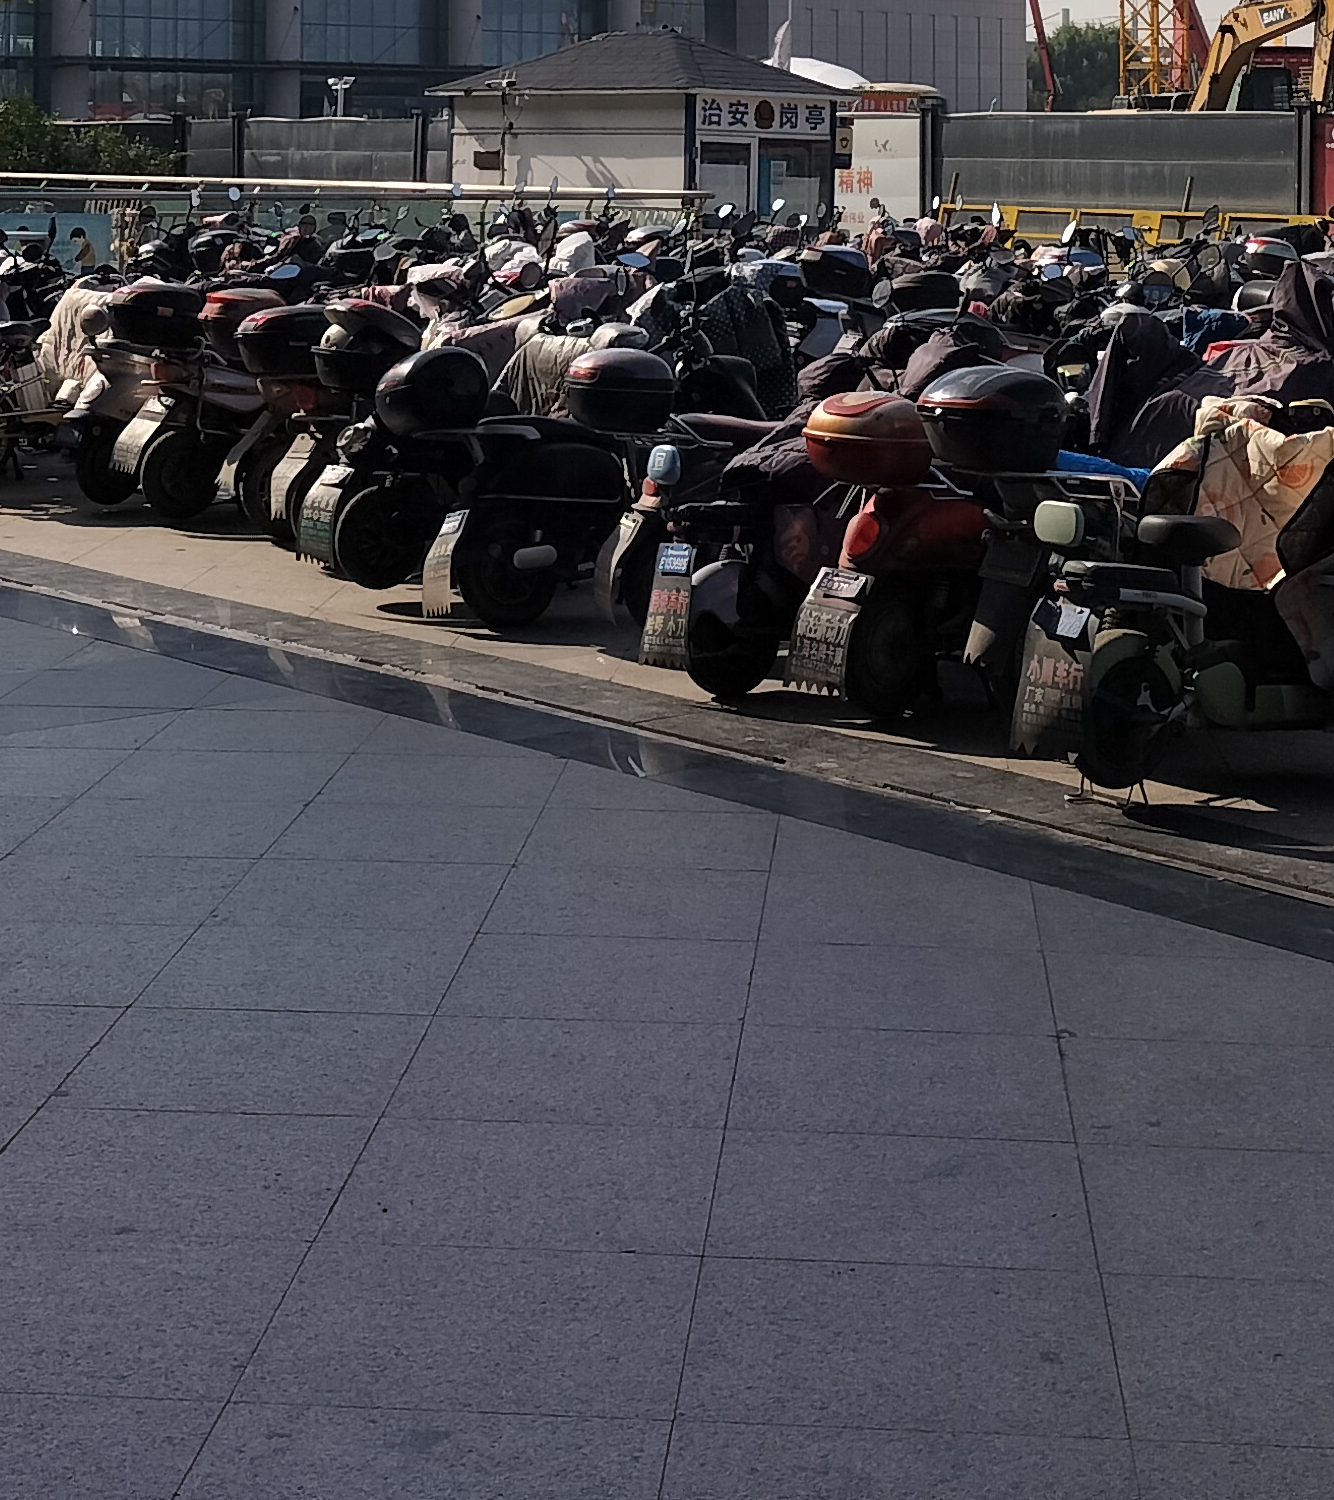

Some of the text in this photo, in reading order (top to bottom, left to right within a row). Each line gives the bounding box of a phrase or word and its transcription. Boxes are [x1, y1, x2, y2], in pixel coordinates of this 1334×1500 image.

[701, 98, 749, 127] 治安
[779, 102, 825, 130] 岗亭
[838, 166, 873, 194] 精神
